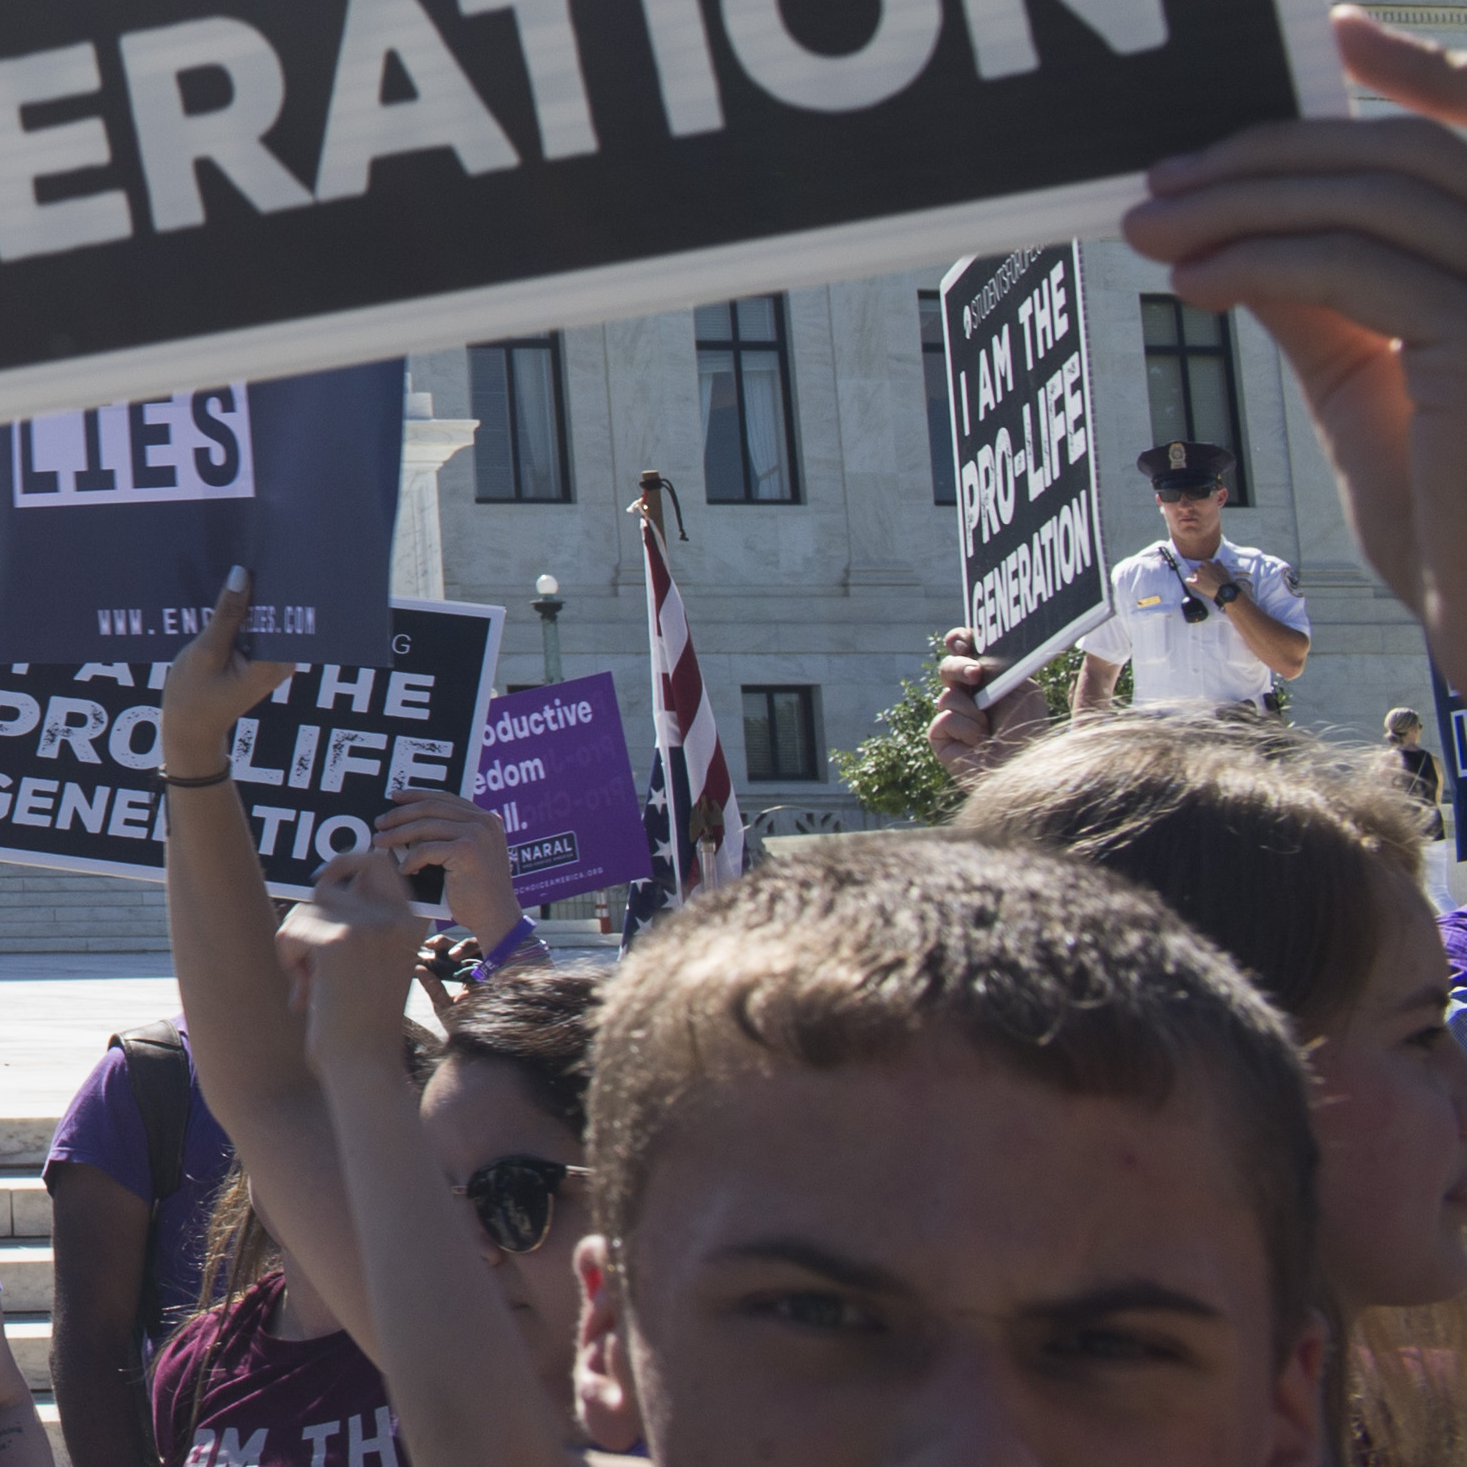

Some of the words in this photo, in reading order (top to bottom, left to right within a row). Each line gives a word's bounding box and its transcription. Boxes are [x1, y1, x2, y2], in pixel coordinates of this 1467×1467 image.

[960, 371, 971, 436] I
[978, 323, 1014, 422] AM
[1018, 259, 1069, 371] THE
[19, 387, 241, 496] LIES
[962, 351, 1087, 558] PRO-LIFE
[973, 489, 1092, 654] GENERATION
[481, 698, 593, 747] oductive
[473, 757, 546, 796] edom
[520, 838, 573, 863] NARAL
[301, 1404, 399, 1467] TH
